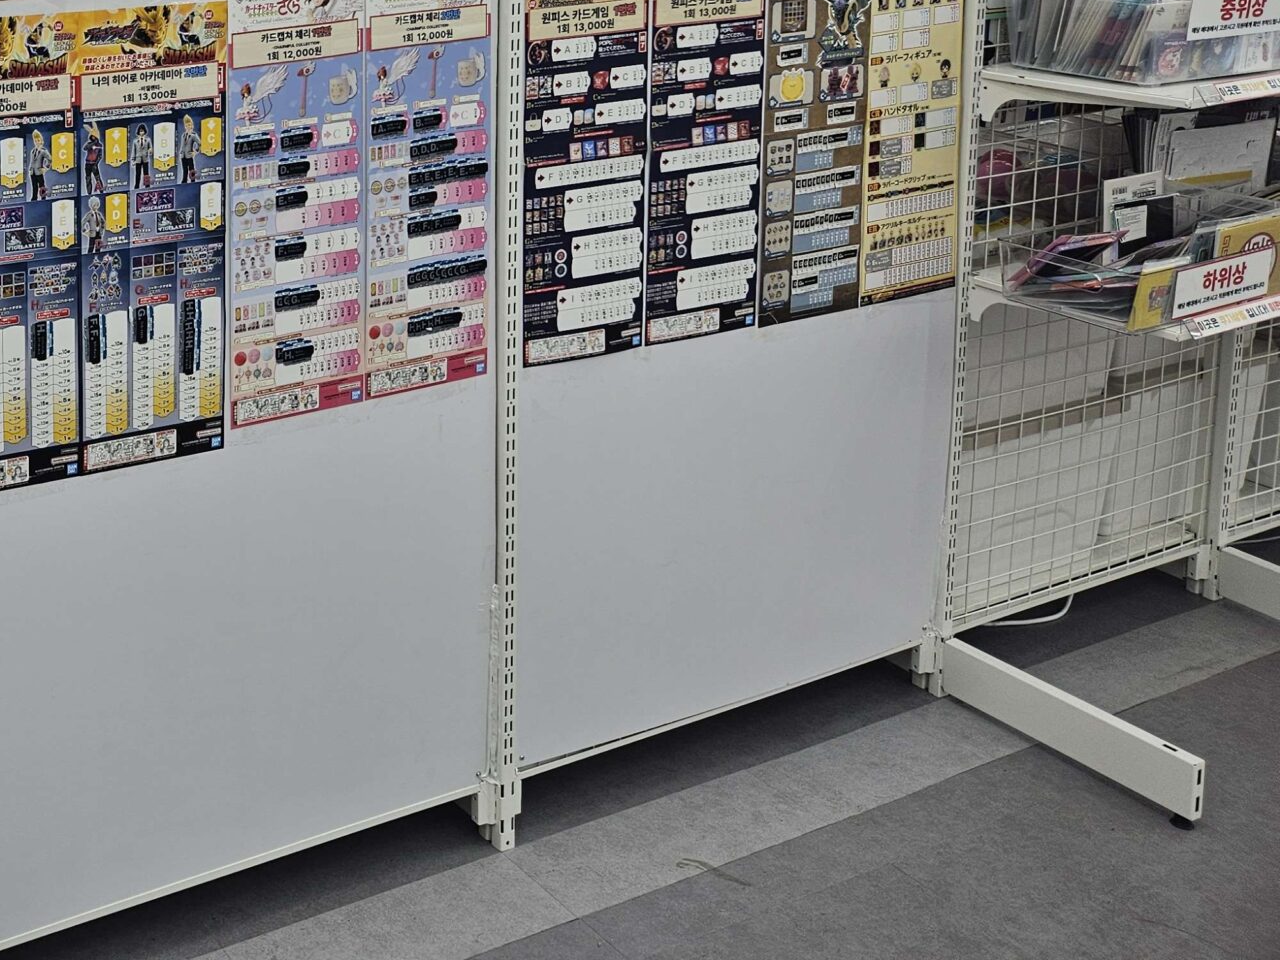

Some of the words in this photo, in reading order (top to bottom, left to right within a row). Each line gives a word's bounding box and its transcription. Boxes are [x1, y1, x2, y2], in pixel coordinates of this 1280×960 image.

[395, 13, 423, 25] 카드캡쳐
[426, 11, 440, 22] 체리
[541, 12, 570, 24] 원피스
[572, 7, 609, 20] 카드게임
[683, 8, 695, 18] 1회
[699, 4, 736, 18] 13,000원
[557, 24, 569, 34] 1회
[574, 19, 614, 33] 13,000원
[260, 30, 293, 43] 카드캡쳐
[297, 28, 311, 39] 체리
[403, 32, 414, 42] 1회
[417, 29, 453, 43] 12,000원
[267, 51, 280, 61] 1회
[283, 46, 322, 60] 12,000원
[886, 50, 932, 64] ラバーフィギュア
[7, 57, 67, 79] SMAASH!!
[92, 75, 110, 87] 나의
[112, 72, 137, 85] 히어로
[140, 69, 182, 82] 아카데미아
[123, 92, 134, 103] 1회
[138, 88, 177, 102] 13,000원
[884, 104, 919, 116] ハンドタオル
[6, 242, 45, 252] VIGILANTES
[1203, 262, 1247, 291] 하위상
